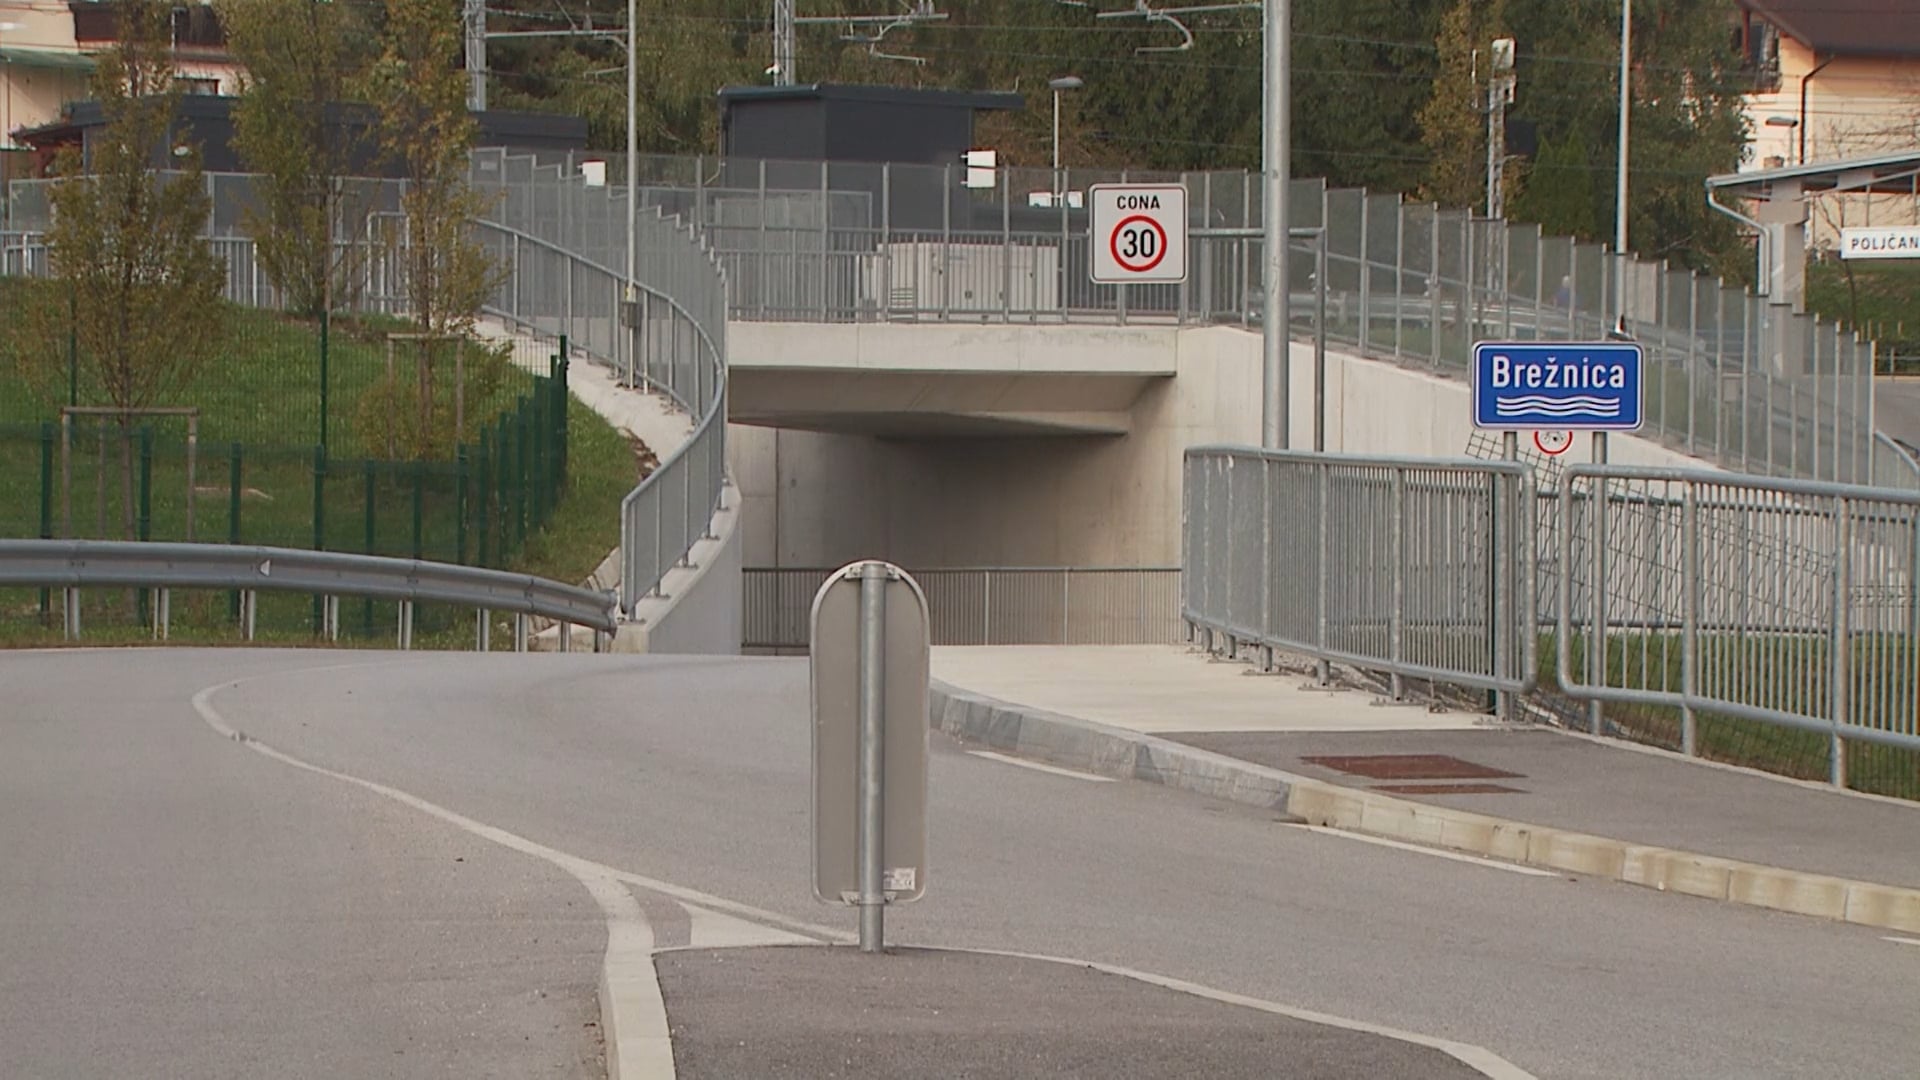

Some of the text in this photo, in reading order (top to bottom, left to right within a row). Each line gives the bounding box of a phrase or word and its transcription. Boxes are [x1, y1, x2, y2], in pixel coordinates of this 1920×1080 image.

[1117, 195, 1160, 210] CONA
[1123, 229, 1155, 258] 30
[1852, 233, 1919, 250] POLJČAN
[1492, 355, 1625, 388] Brežnica
